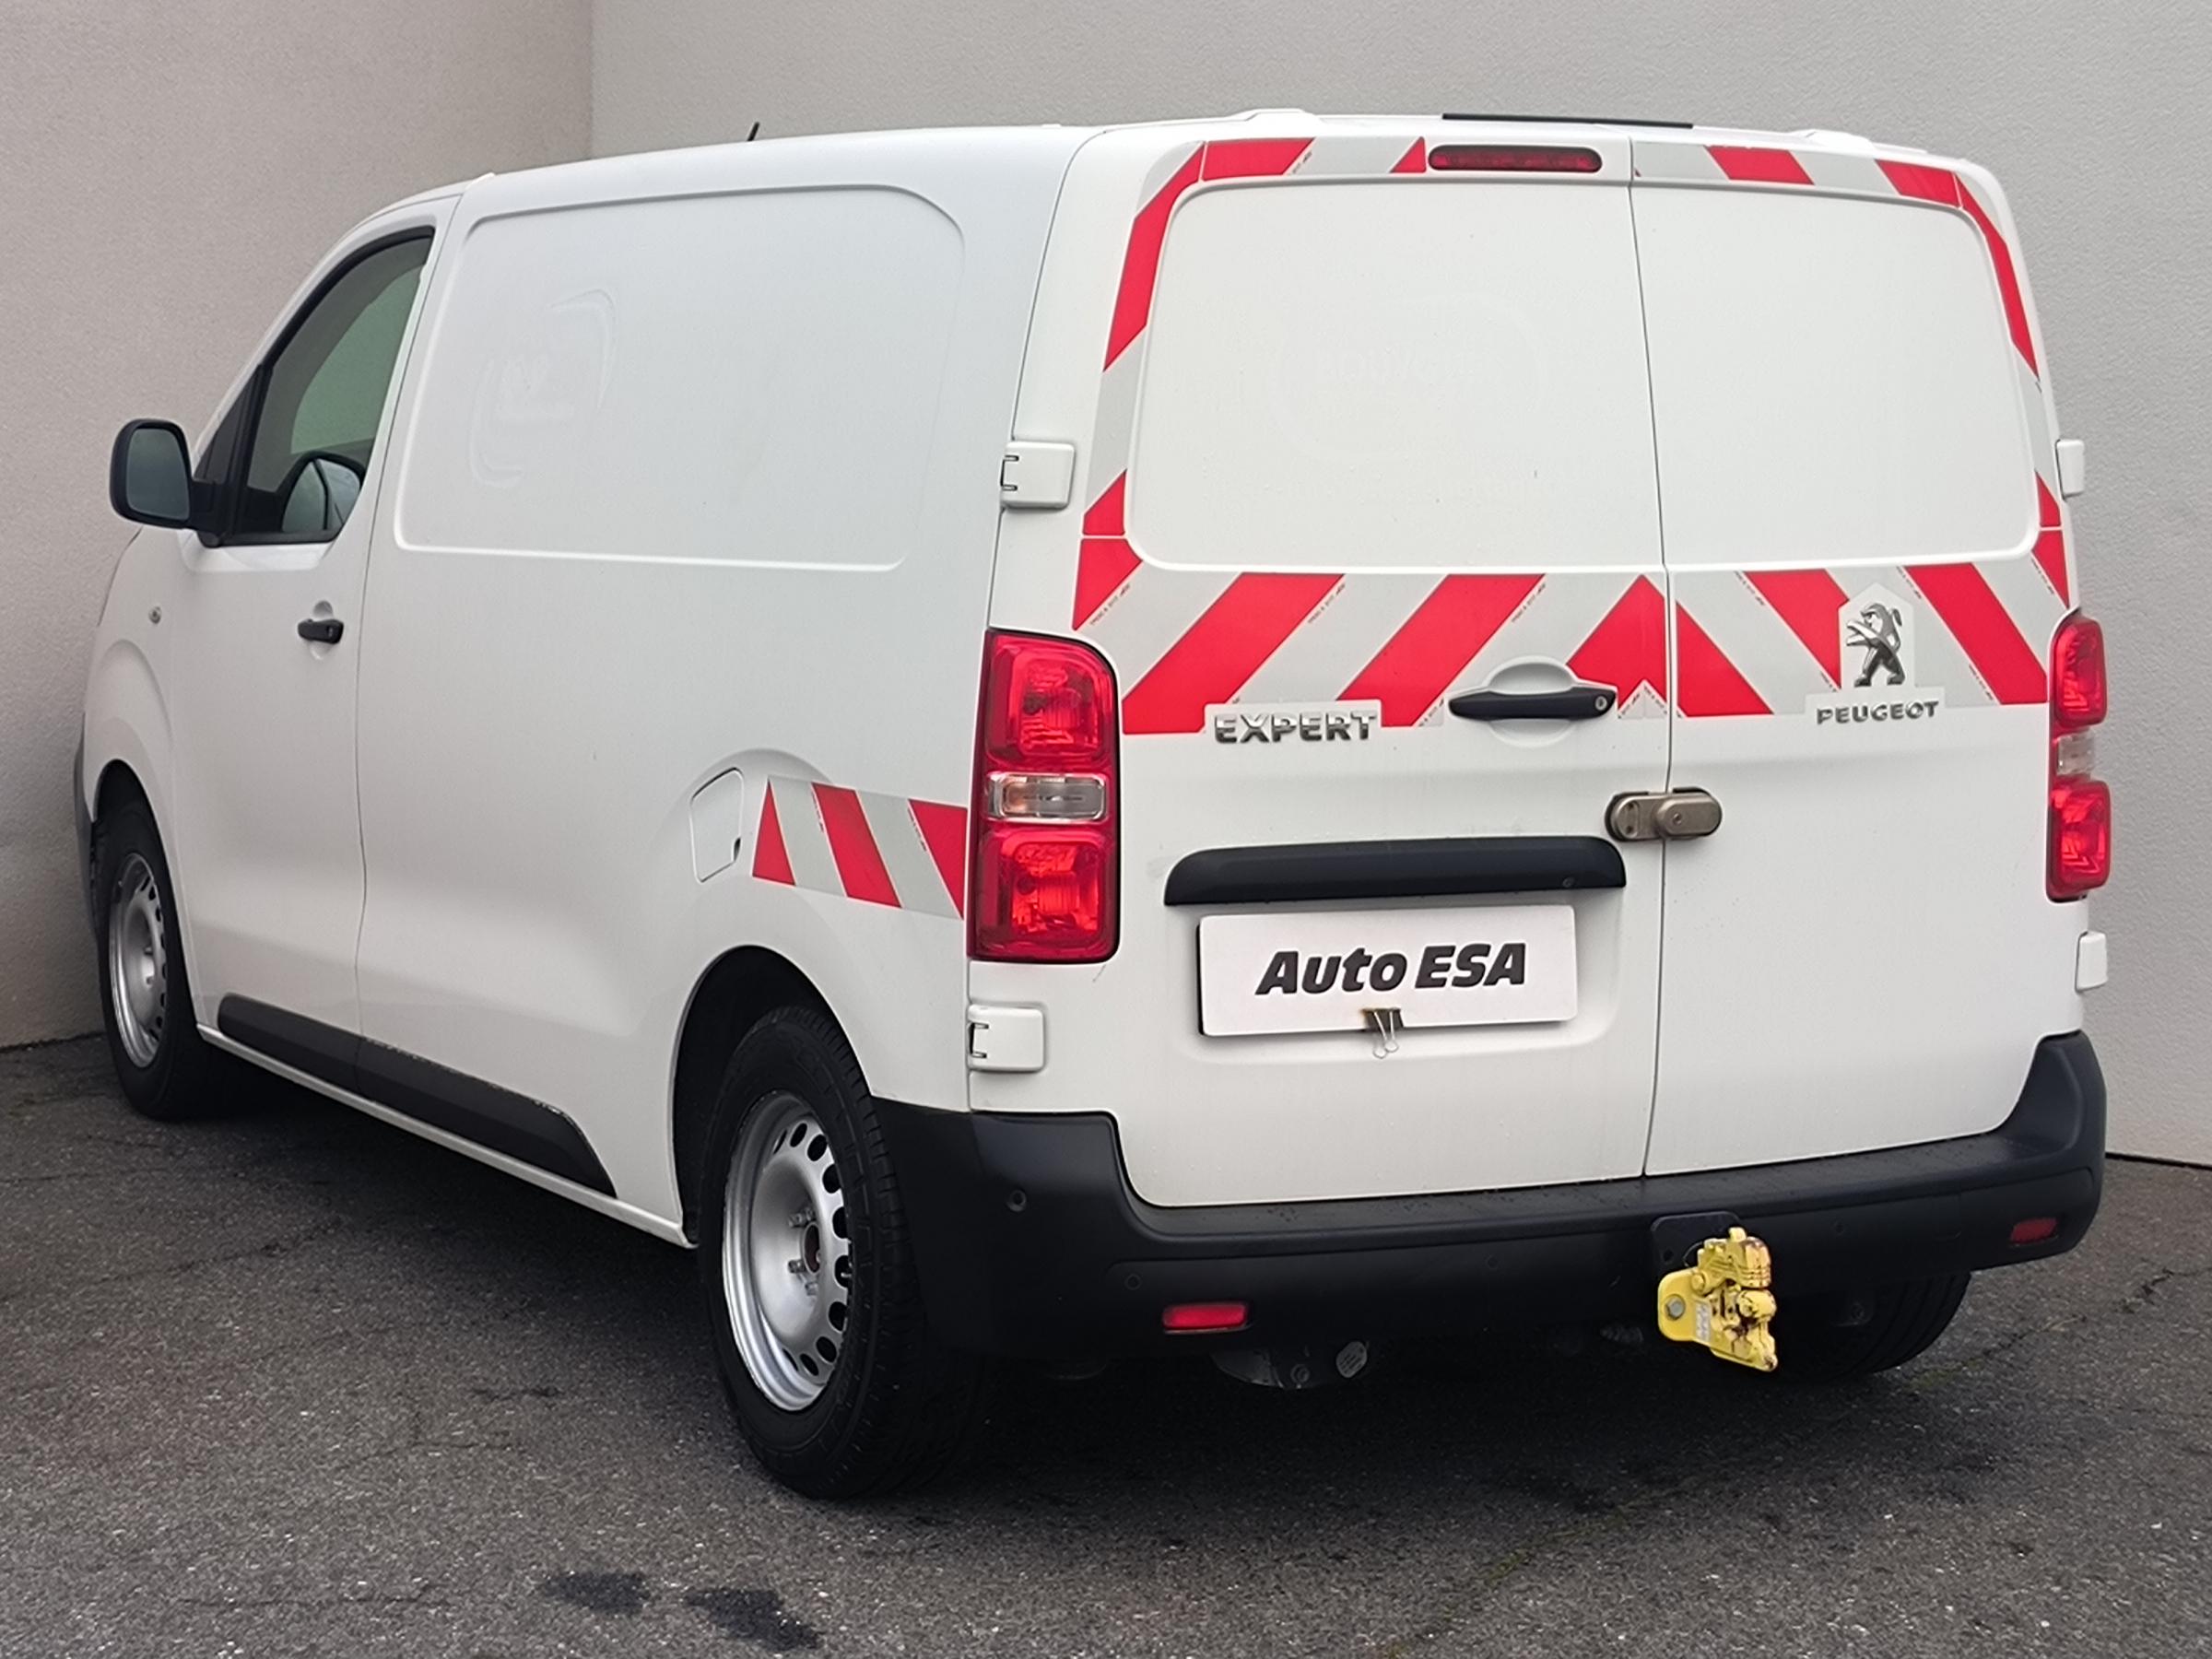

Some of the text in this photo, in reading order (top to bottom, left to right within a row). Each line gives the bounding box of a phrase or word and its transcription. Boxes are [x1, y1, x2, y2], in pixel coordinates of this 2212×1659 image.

[1214, 711, 1377, 744] EXPERT
[1817, 700, 1939, 725] PEUGEOT
[1254, 943, 1526, 995] Auto ESA
